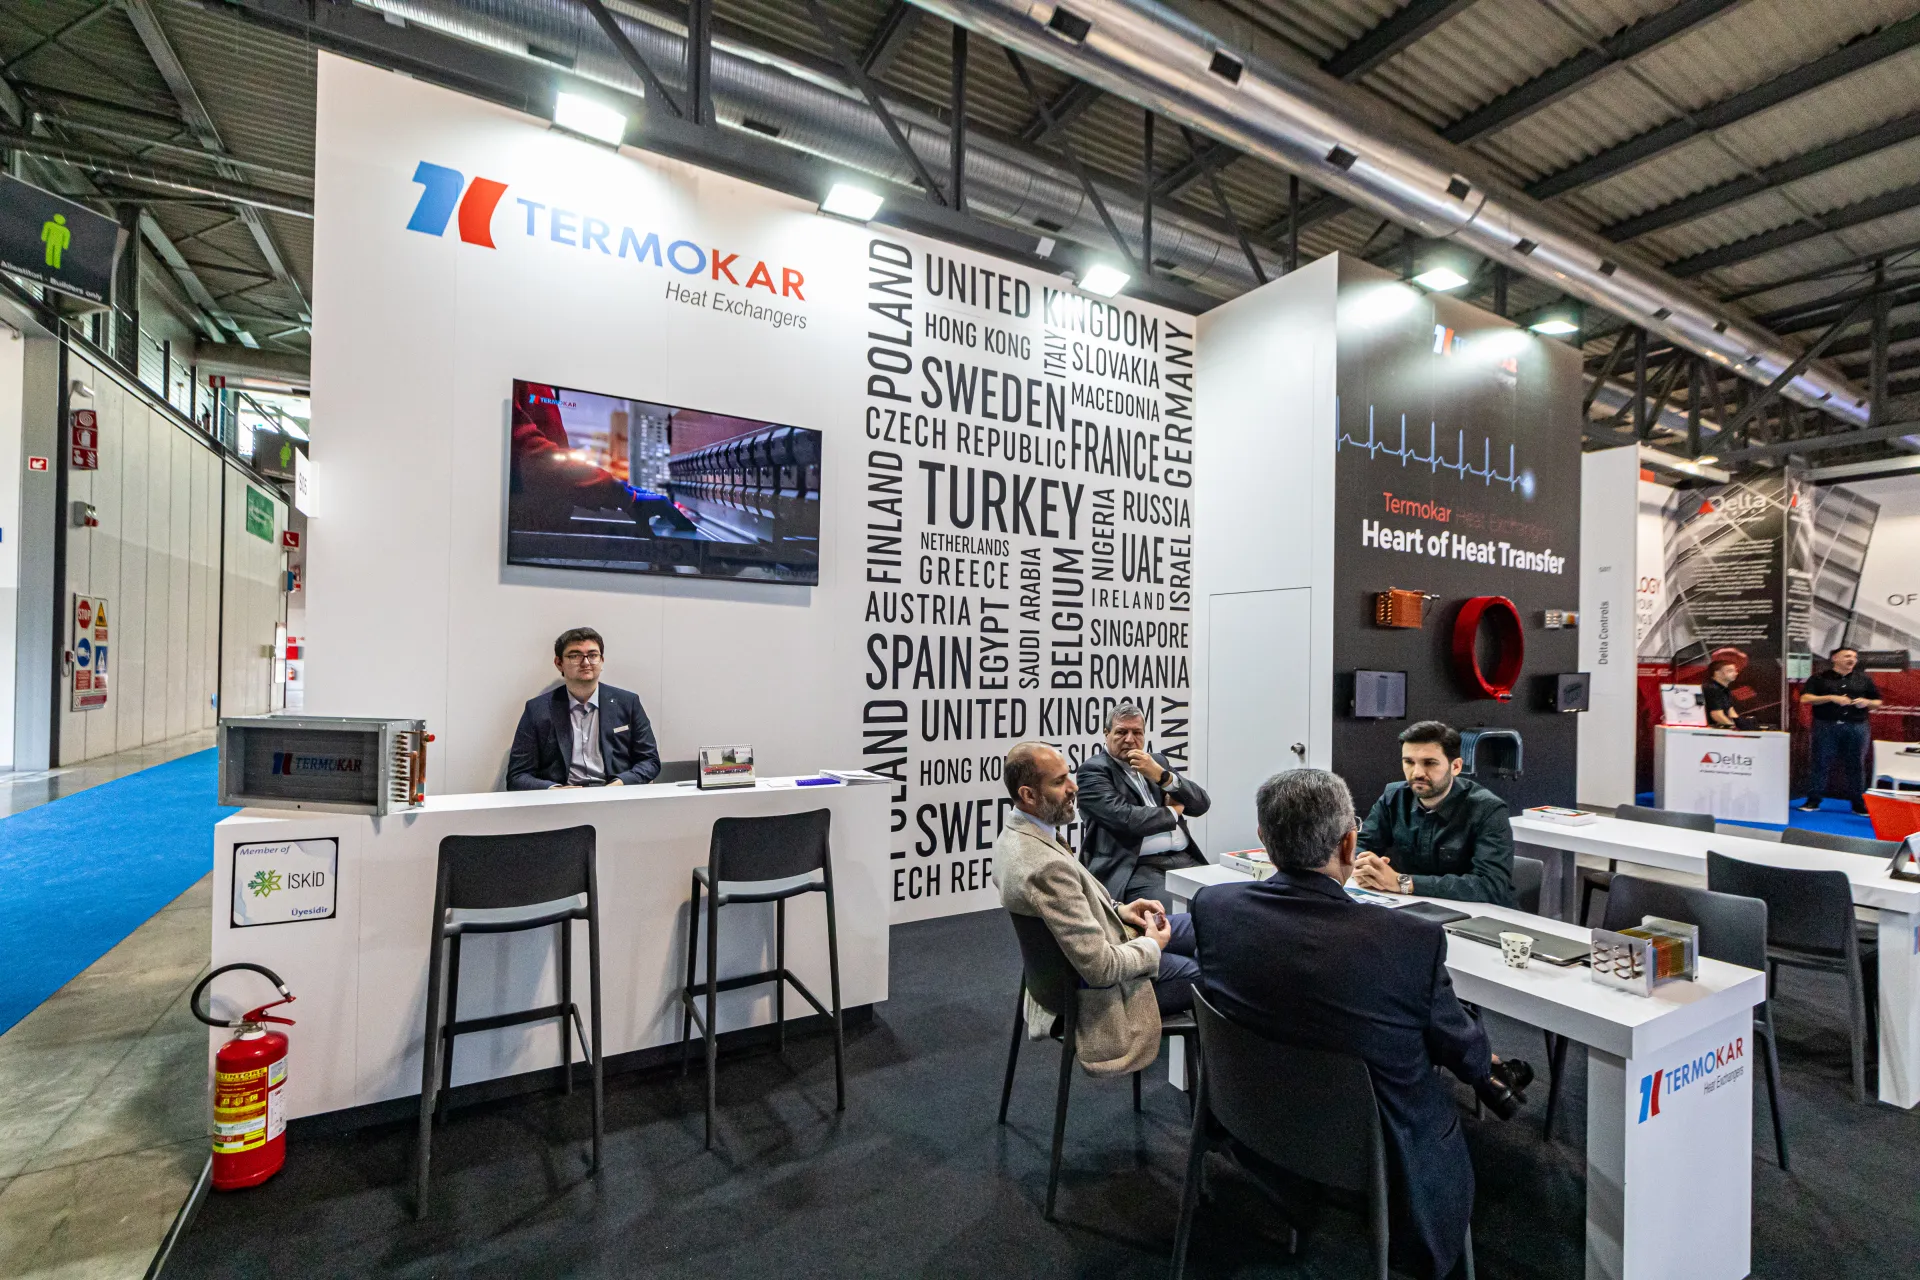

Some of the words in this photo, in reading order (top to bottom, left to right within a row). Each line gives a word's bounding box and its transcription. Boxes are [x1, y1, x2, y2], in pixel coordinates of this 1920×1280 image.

[516, 197, 807, 301] TERMOKAR
[665, 281, 708, 308] Heat
[712, 292, 808, 329] Exchangers
[867, 238, 913, 403] POLAND
[926, 253, 1031, 319] UNITED
[1043, 286, 1158, 353] KINGDOM
[925, 312, 977, 348] HONG
[984, 326, 1031, 360] KONG
[1044, 329, 1066, 379] ITALY
[1072, 341, 1160, 389] SLOVAKIA
[921, 355, 1066, 432] SWEDEN
[1071, 381, 1160, 423] MACEDONIA
[1164, 320, 1193, 489] GERMANY
[865, 406, 946, 451] CZECH
[957, 421, 1066, 470] REPUBLIC
[1071, 418, 1160, 483] FRANCE
[866, 450, 903, 584] FINLAND
[918, 459, 1084, 540] TURKEY
[1123, 490, 1191, 529] RUSSIA
[1383, 491, 1452, 523] Termokar
[1705, 493, 1767, 513] Delta
[920, 531, 1010, 557] NETHERLANDS
[1091, 489, 1115, 581] NIGERIA
[1122, 533, 1165, 584] UAE
[1362, 518, 1424, 555] Heart
[1427, 530, 1450, 558] of
[1452, 533, 1496, 565] Heat
[1498, 541, 1566, 575] Transfer
[919, 555, 1009, 590] GREECE
[1020, 547, 1041, 621] ARABIA
[1170, 534, 1191, 611] ISRAEL
[78, 608, 92, 619] STOP
[865, 591, 971, 626] AUSTRIA
[1051, 547, 1084, 689] BELGIUM
[1092, 588, 1165, 611] IRELAND
[1598, 600, 1610, 640] Controls
[1887, 593, 1918, 606] OF
[980, 596, 1009, 690] EGYPT
[1090, 618, 1189, 649] SINGAPORE
[1598, 641, 1609, 665] Delta
[865, 633, 972, 690] SPAIN
[1019, 629, 1040, 689] SAUDI
[1090, 653, 1190, 689] ROMANIA
[921, 697, 1027, 742] UNITED
[1039, 696, 1155, 737] KINGM
[296, 757, 362, 772] TERMOKAR
[920, 757, 972, 787] HONG
[1706, 751, 1752, 766] Delta
[239, 847, 279, 855] Member
[281, 845, 291, 855] of
[291, 906, 328, 917] Üyesidir
[1665, 1037, 1744, 1095] TERMOKAR
[1703, 1080, 1717, 1095] Heat
[1717, 1066, 1744, 1089] Exchangers
